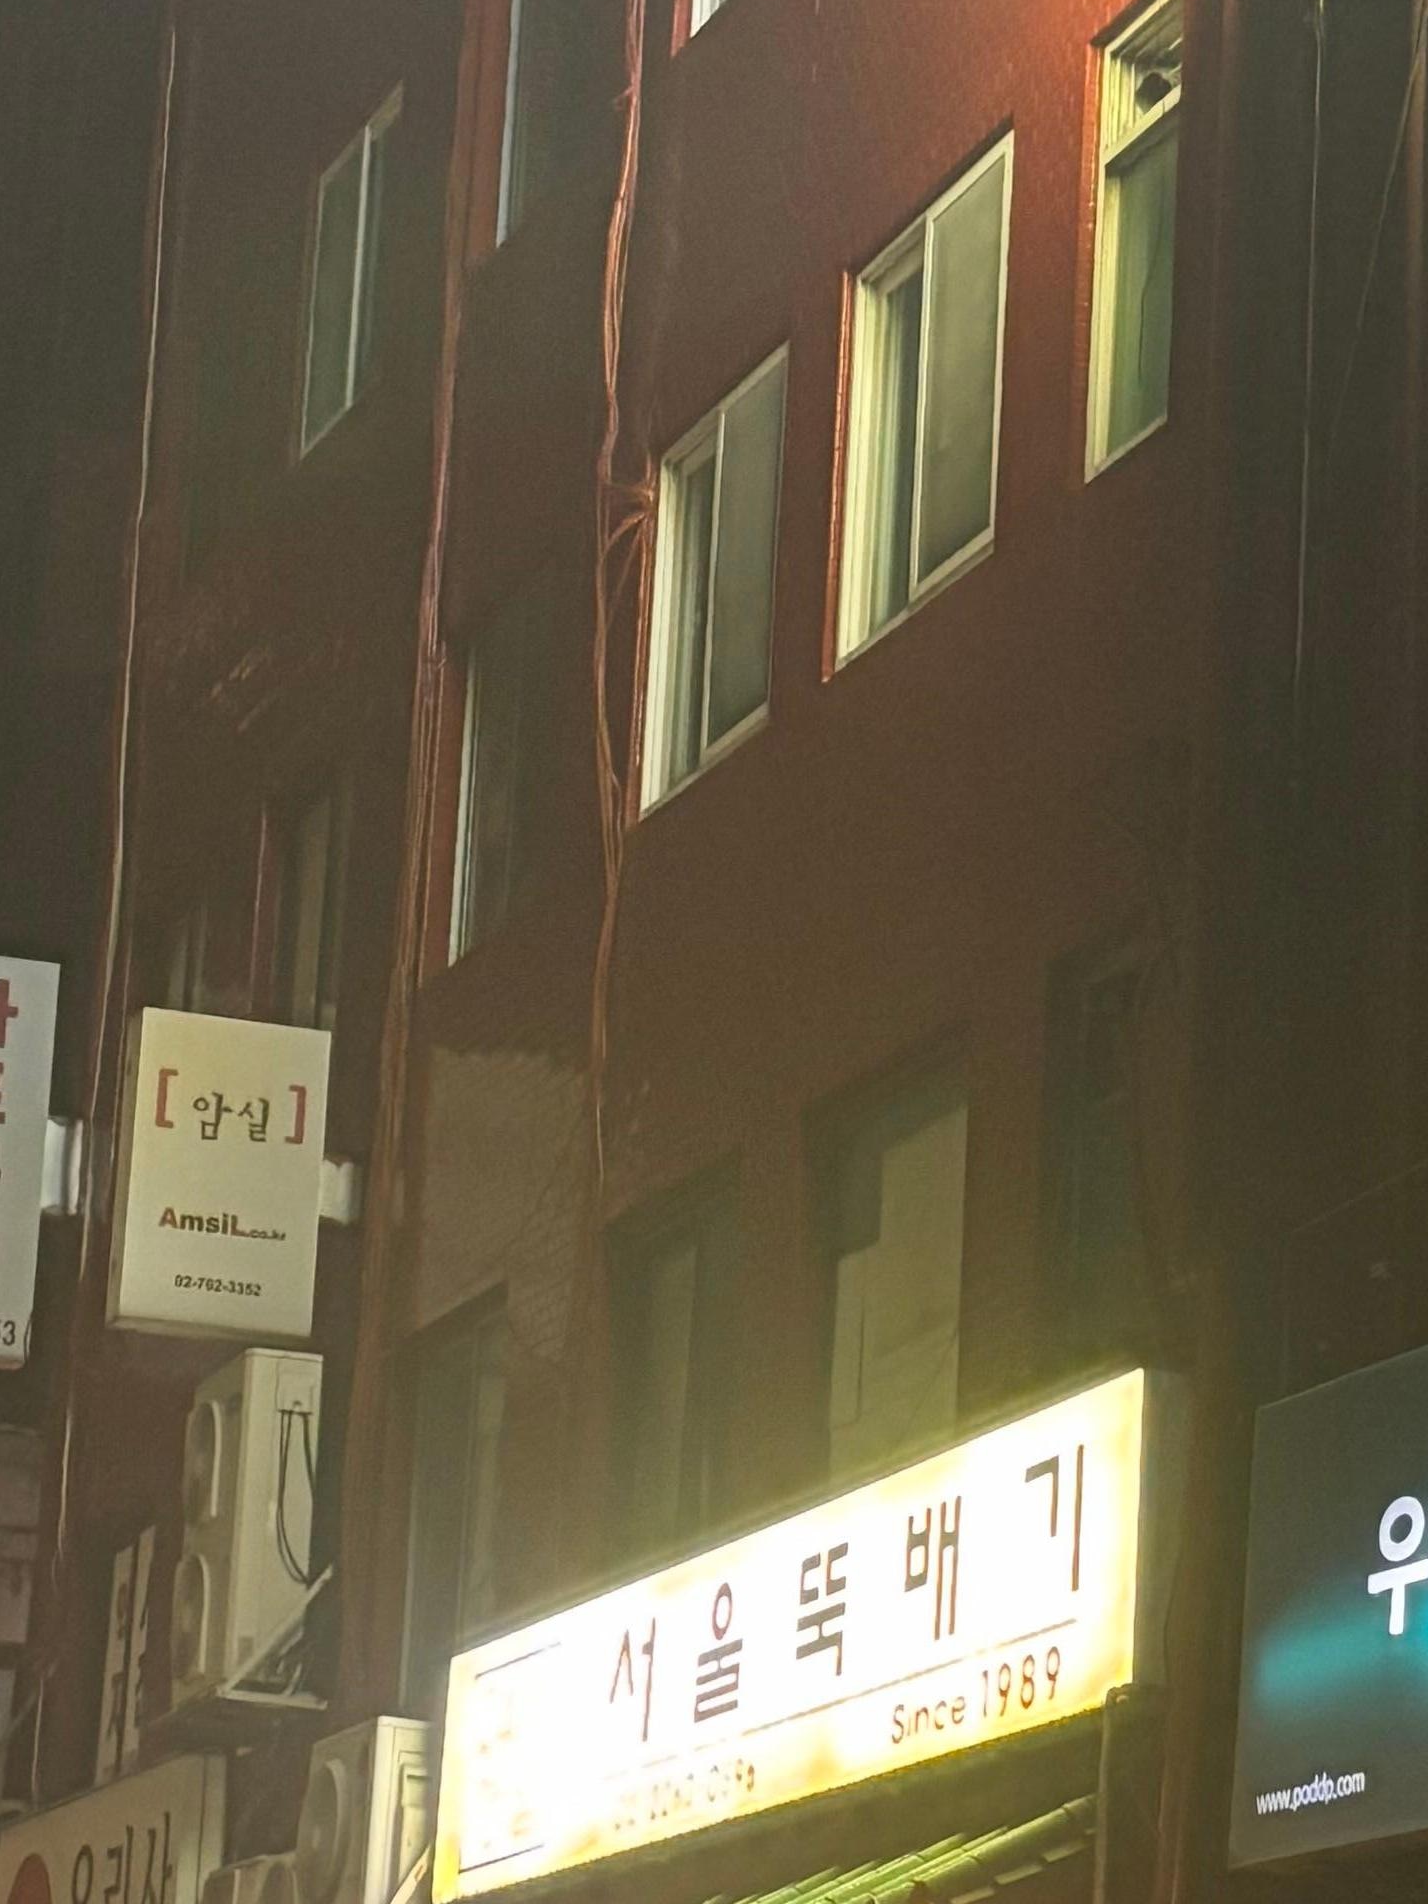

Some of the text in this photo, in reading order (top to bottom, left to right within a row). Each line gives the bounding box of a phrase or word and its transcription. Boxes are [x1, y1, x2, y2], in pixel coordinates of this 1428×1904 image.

[609, 1443, 1085, 1742] 서울뚝배기
[891, 1646, 1061, 1744] Since 1989
